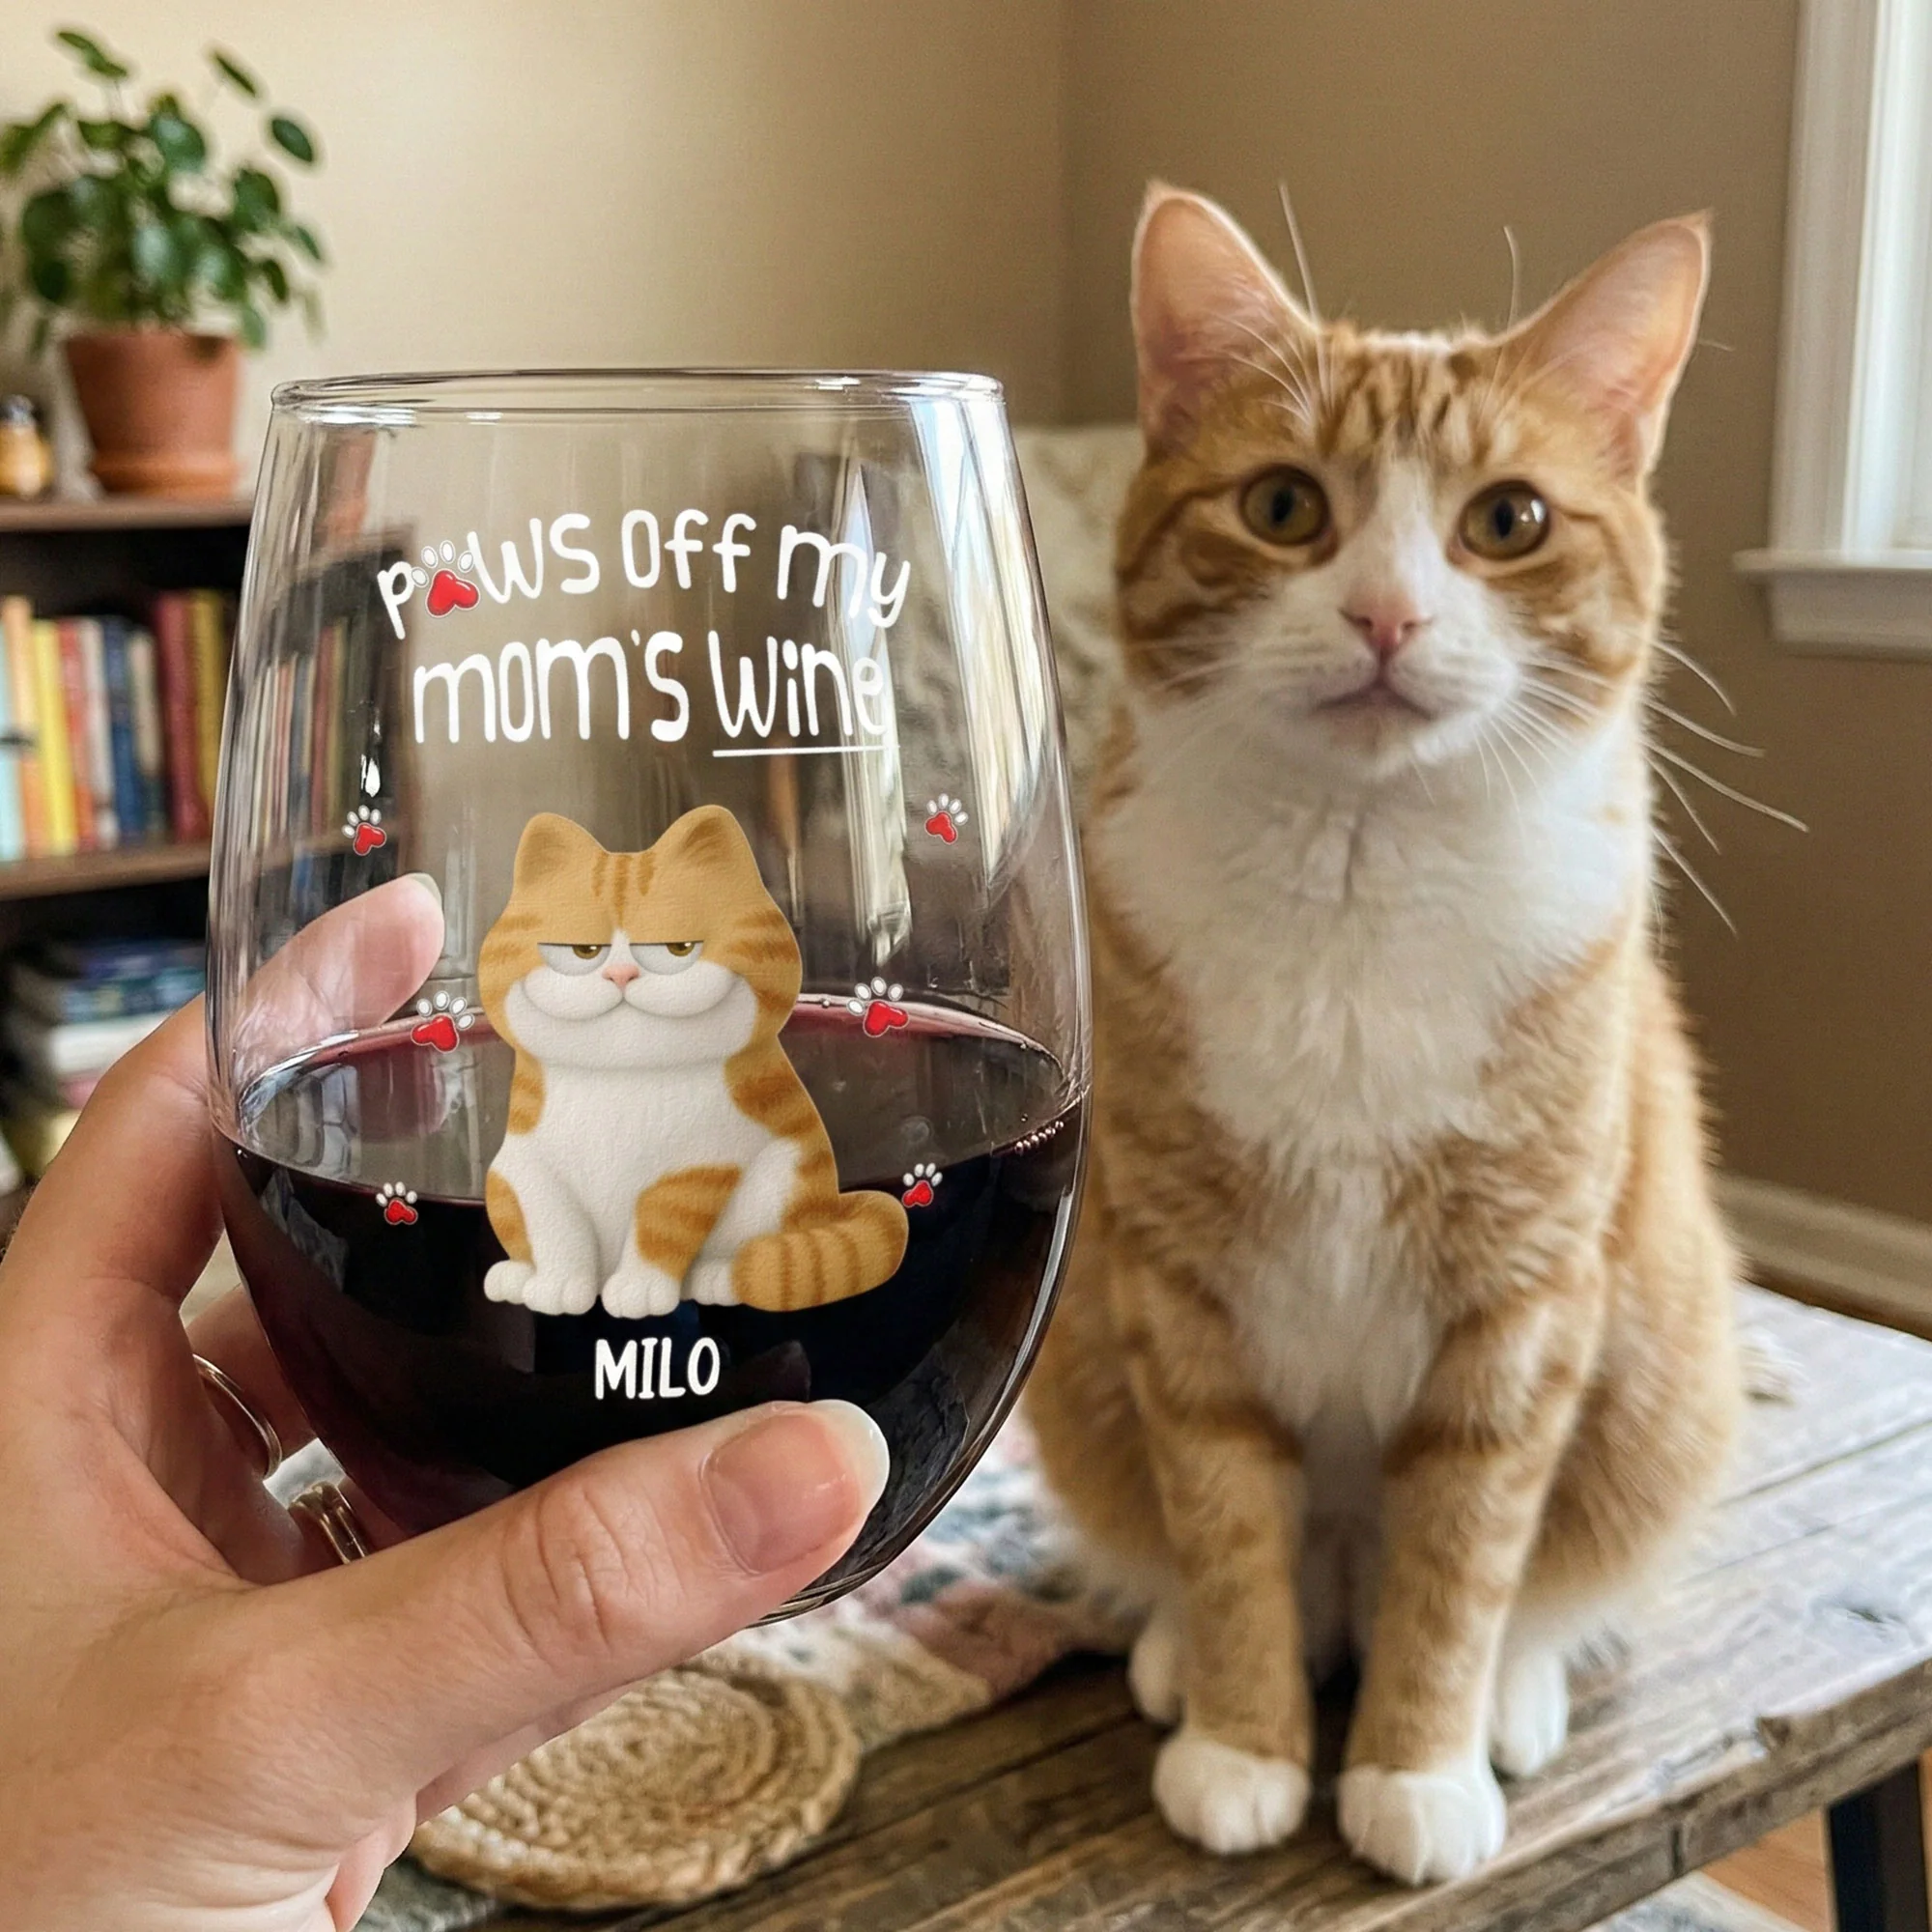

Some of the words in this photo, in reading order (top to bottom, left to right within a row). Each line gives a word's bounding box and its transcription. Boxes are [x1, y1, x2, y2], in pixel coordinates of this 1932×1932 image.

[377, 513, 602, 639] pws
[777, 525, 911, 628] my
[412, 630, 691, 744] mom's
[595, 1336, 721, 1400] MILO
